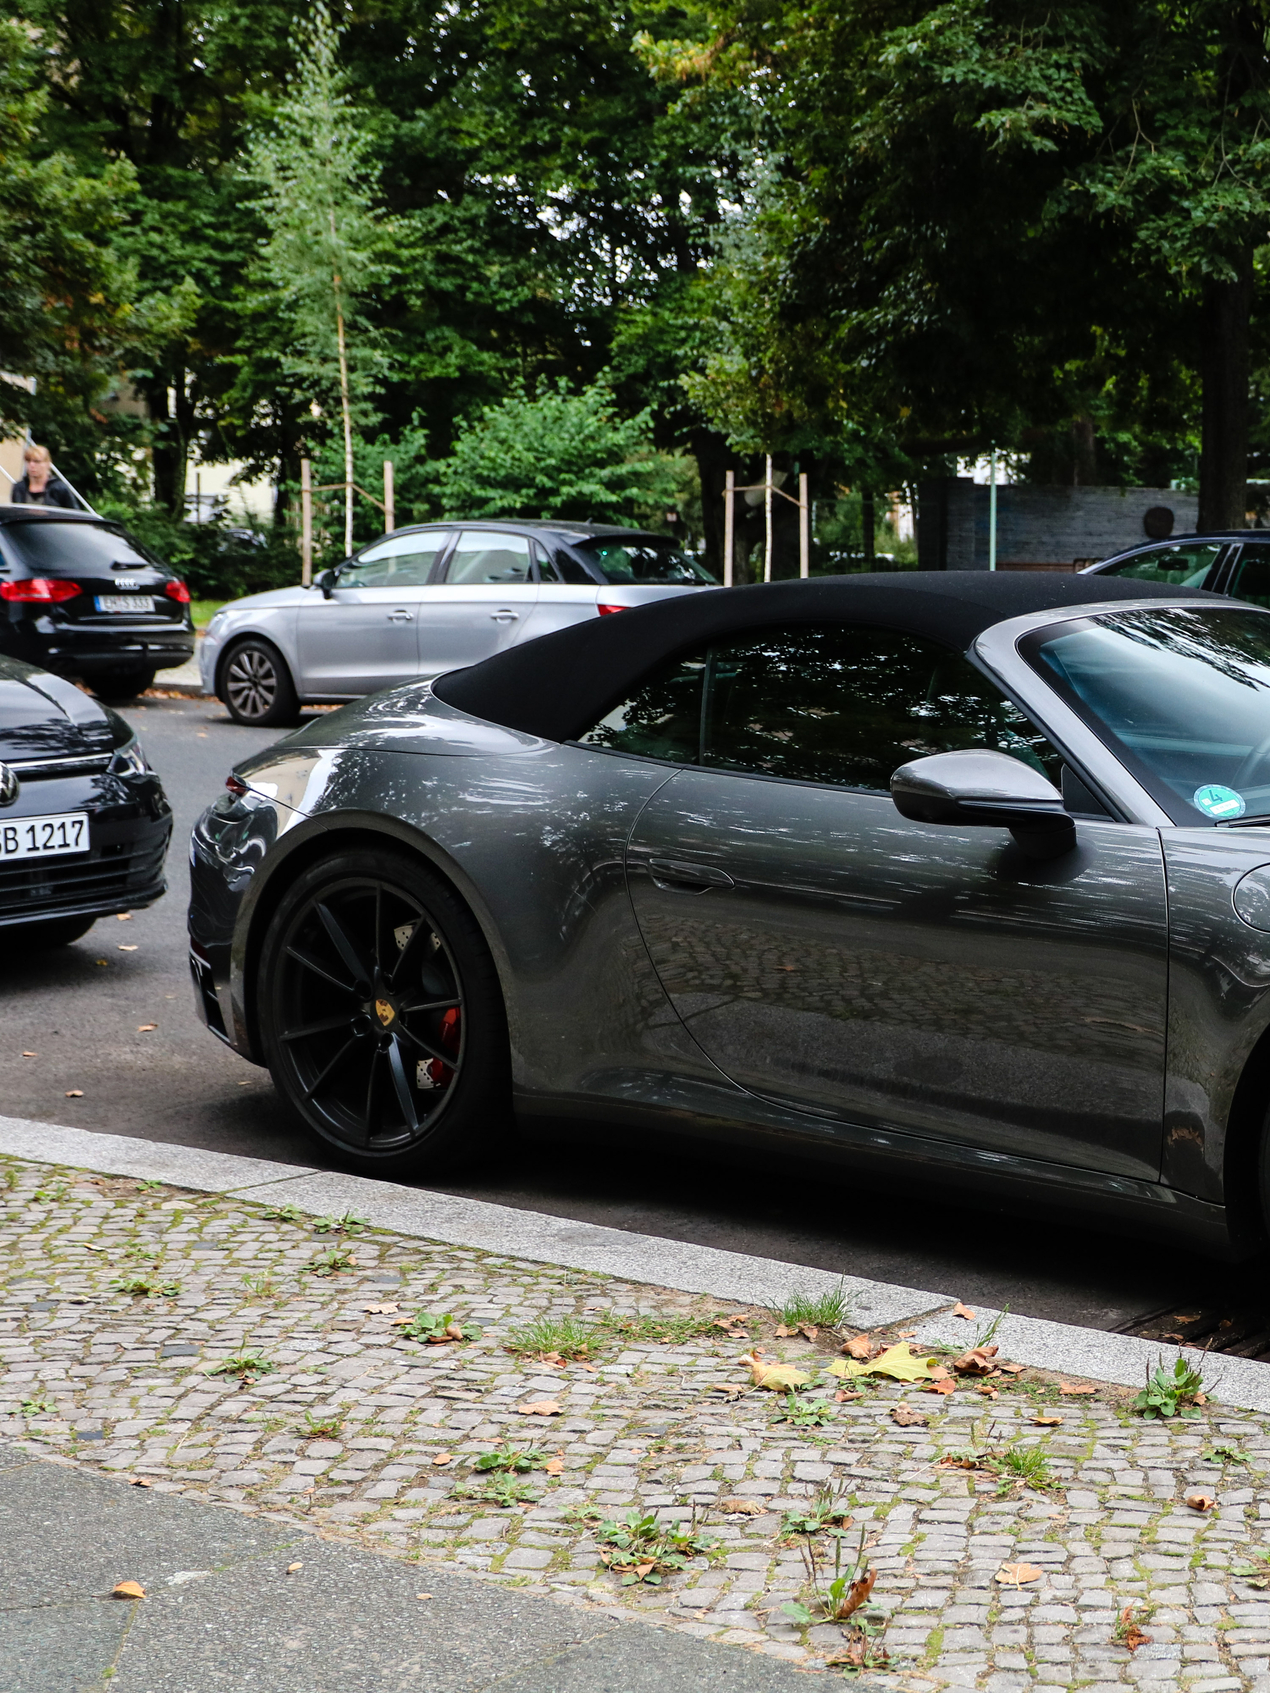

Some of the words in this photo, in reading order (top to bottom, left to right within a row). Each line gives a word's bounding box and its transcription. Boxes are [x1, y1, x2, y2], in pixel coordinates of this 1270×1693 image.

[1209, 789, 1223, 802] 4
[0, 826, 19, 855] B
[26, 819, 84, 852] 1217
